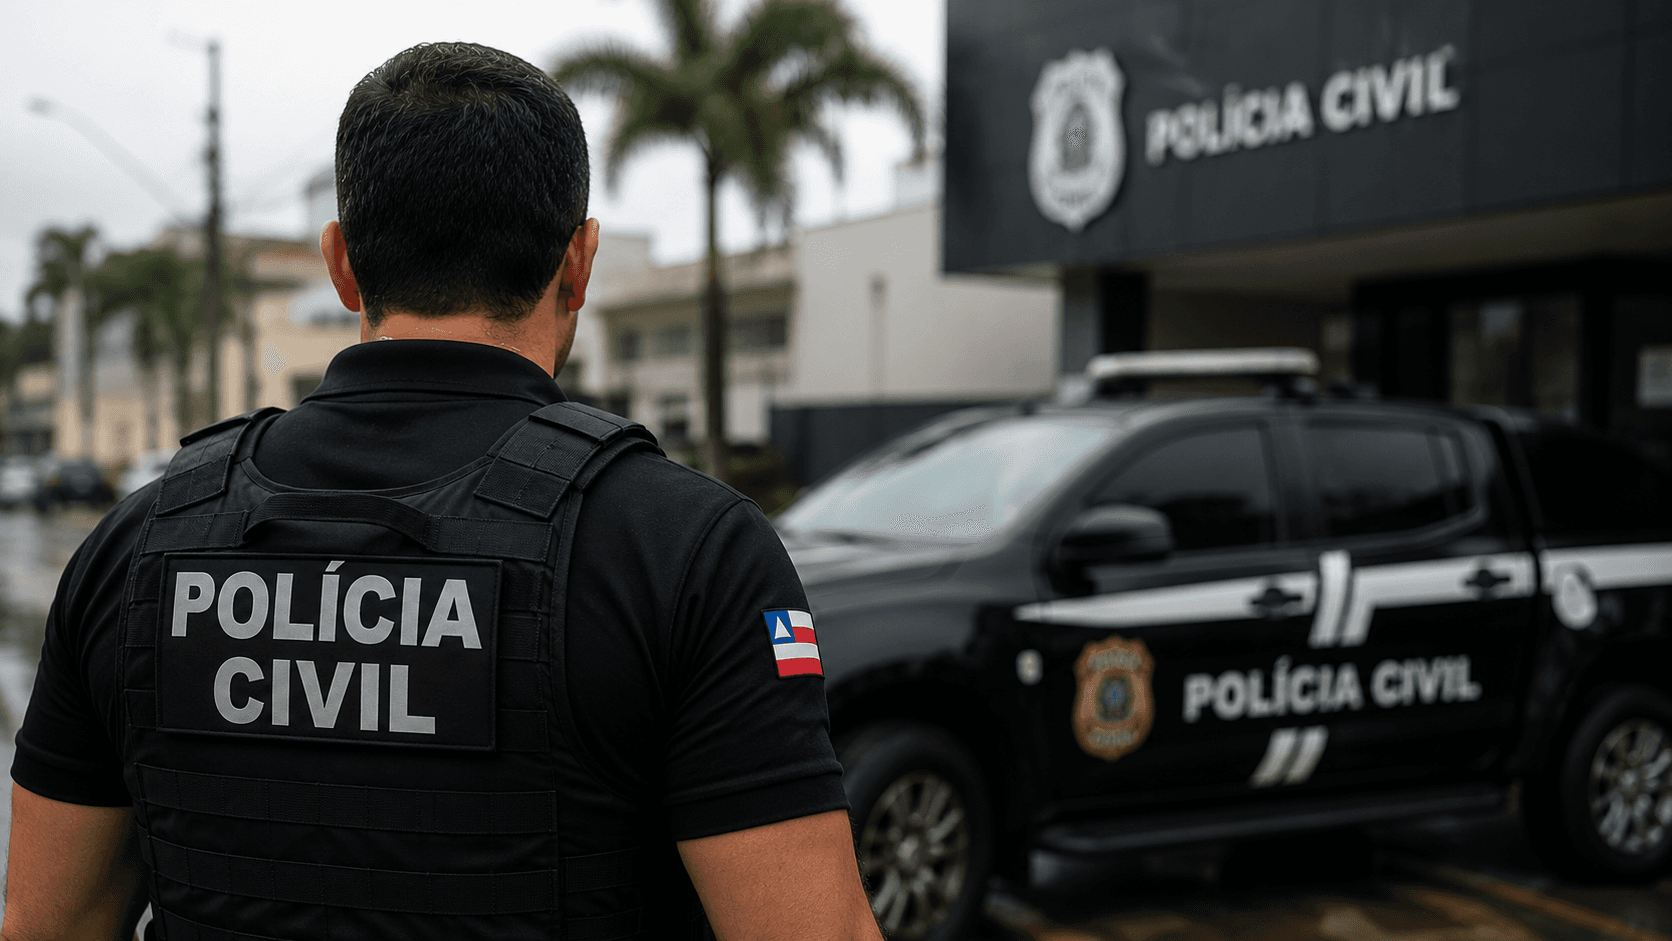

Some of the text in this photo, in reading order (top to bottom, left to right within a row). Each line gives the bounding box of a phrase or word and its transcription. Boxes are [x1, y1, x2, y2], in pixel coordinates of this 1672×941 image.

[1146, 45, 1459, 166] POLÍCIA CIVIL
[171, 560, 483, 650] POLÍCIA
[213, 656, 436, 735] CIVIL
[1183, 655, 1482, 723] POLÍCIA CIVIL
